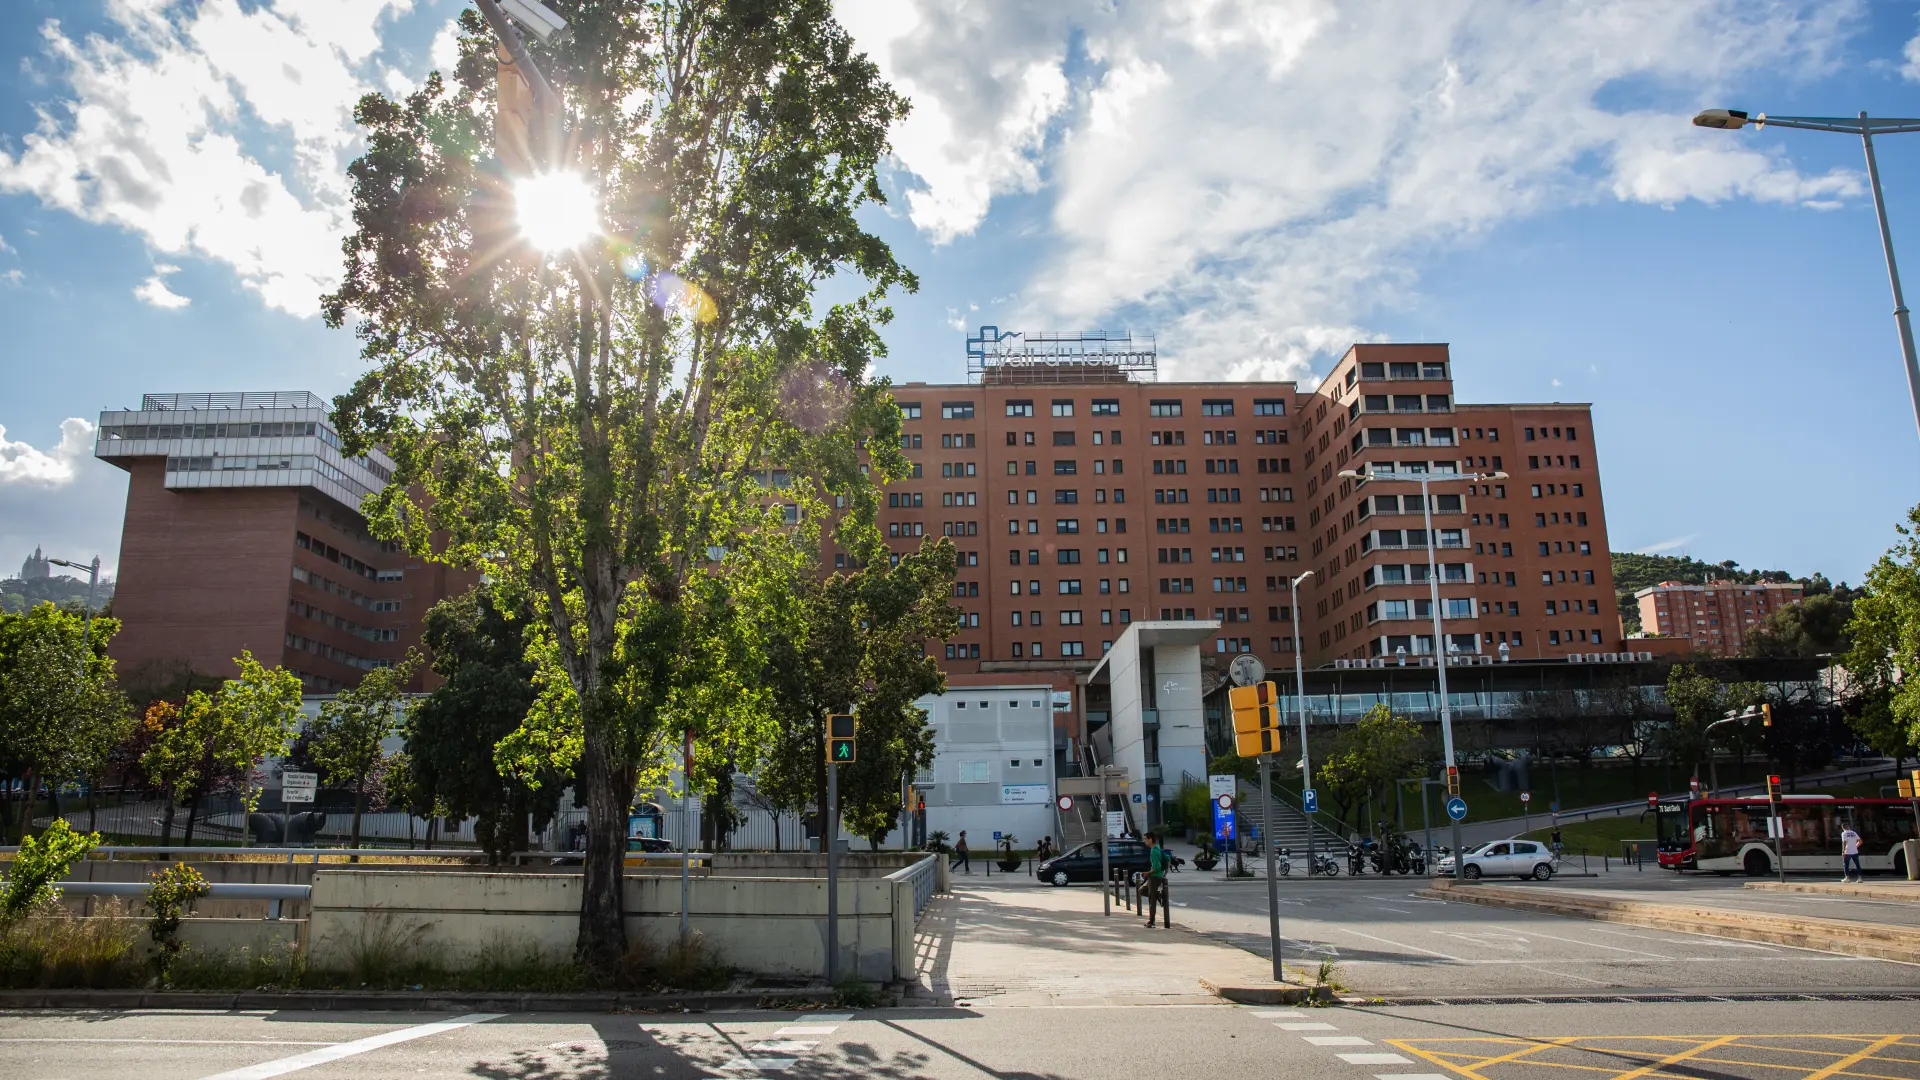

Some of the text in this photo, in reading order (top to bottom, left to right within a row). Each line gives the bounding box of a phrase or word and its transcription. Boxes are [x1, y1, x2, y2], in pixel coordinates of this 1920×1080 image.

[994, 347, 1156, 367] Vall d'Hebron
[1305, 791, 1315, 804] P
